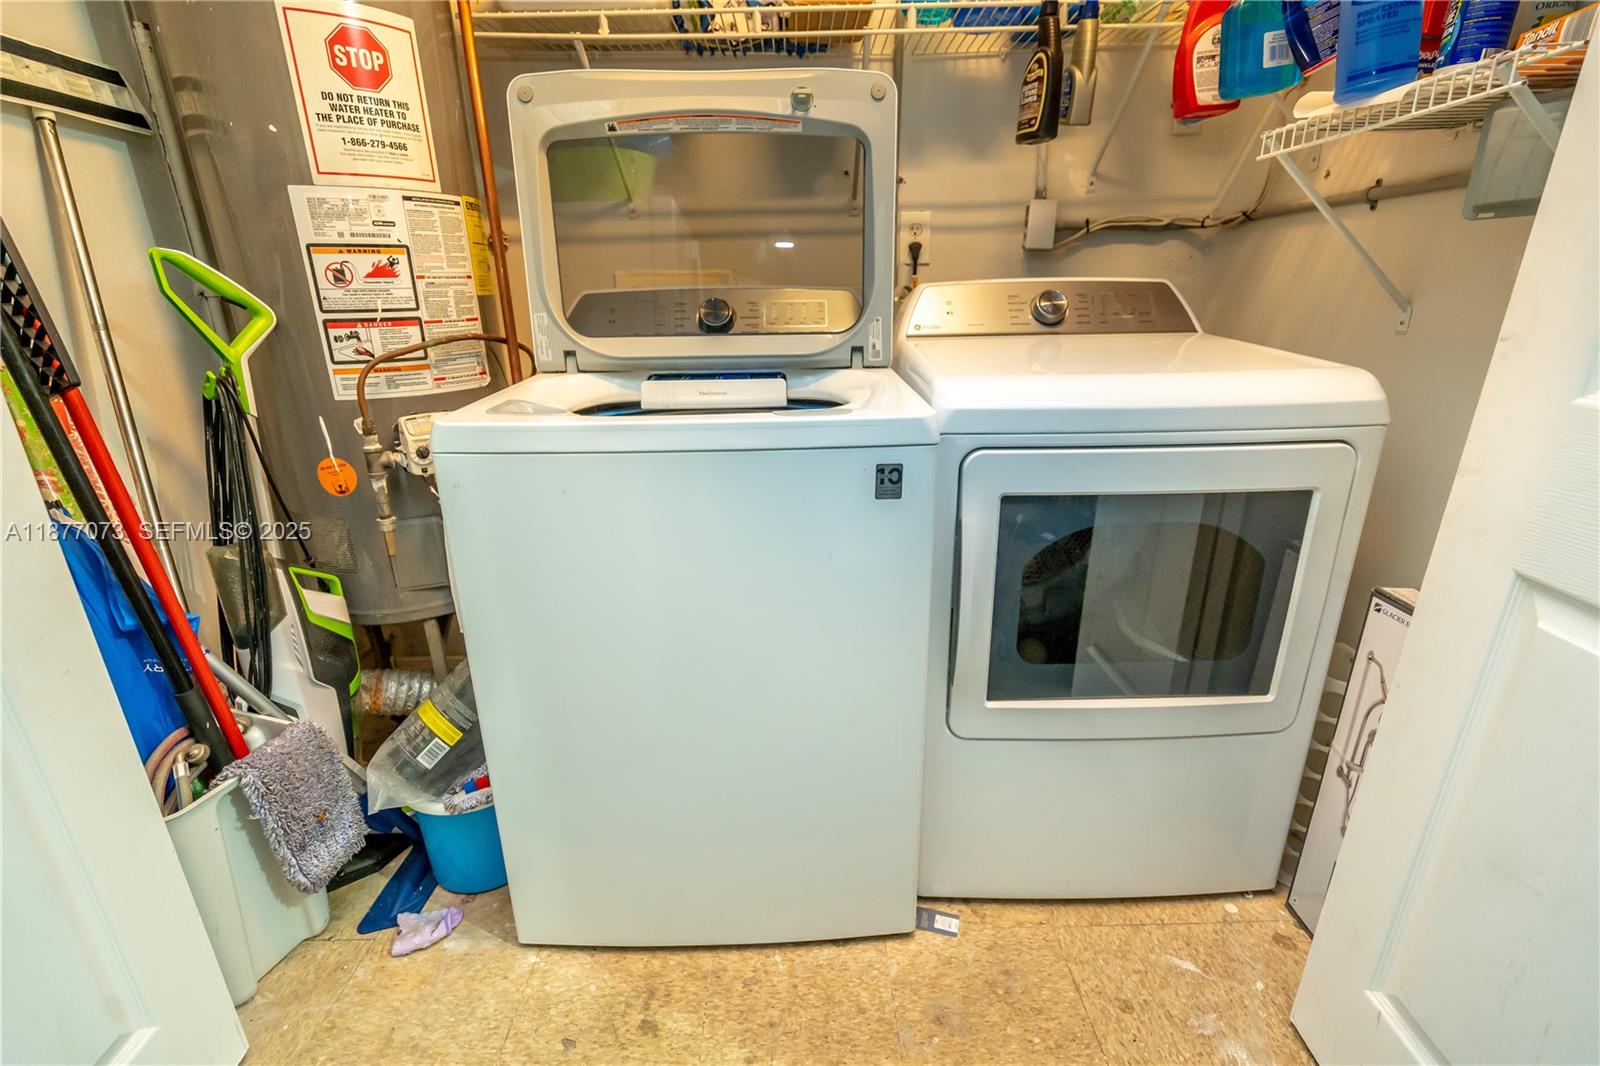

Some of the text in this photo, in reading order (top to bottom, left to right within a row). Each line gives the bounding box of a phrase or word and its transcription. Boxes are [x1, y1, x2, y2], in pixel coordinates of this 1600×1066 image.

[333, 44, 384, 72] STOP
[320, 91, 410, 111] DO NOT RETURN THIS
[329, 103, 407, 120] WATER HEATER TO
[315, 112, 334, 123] THE
[336, 114, 365, 125] PLACE
[367, 117, 378, 126] OF
[380, 119, 420, 133] PURCHASE
[341, 137, 408, 151] 1-866-279-4566
[1382, 608, 1405, 626] GLACIER
